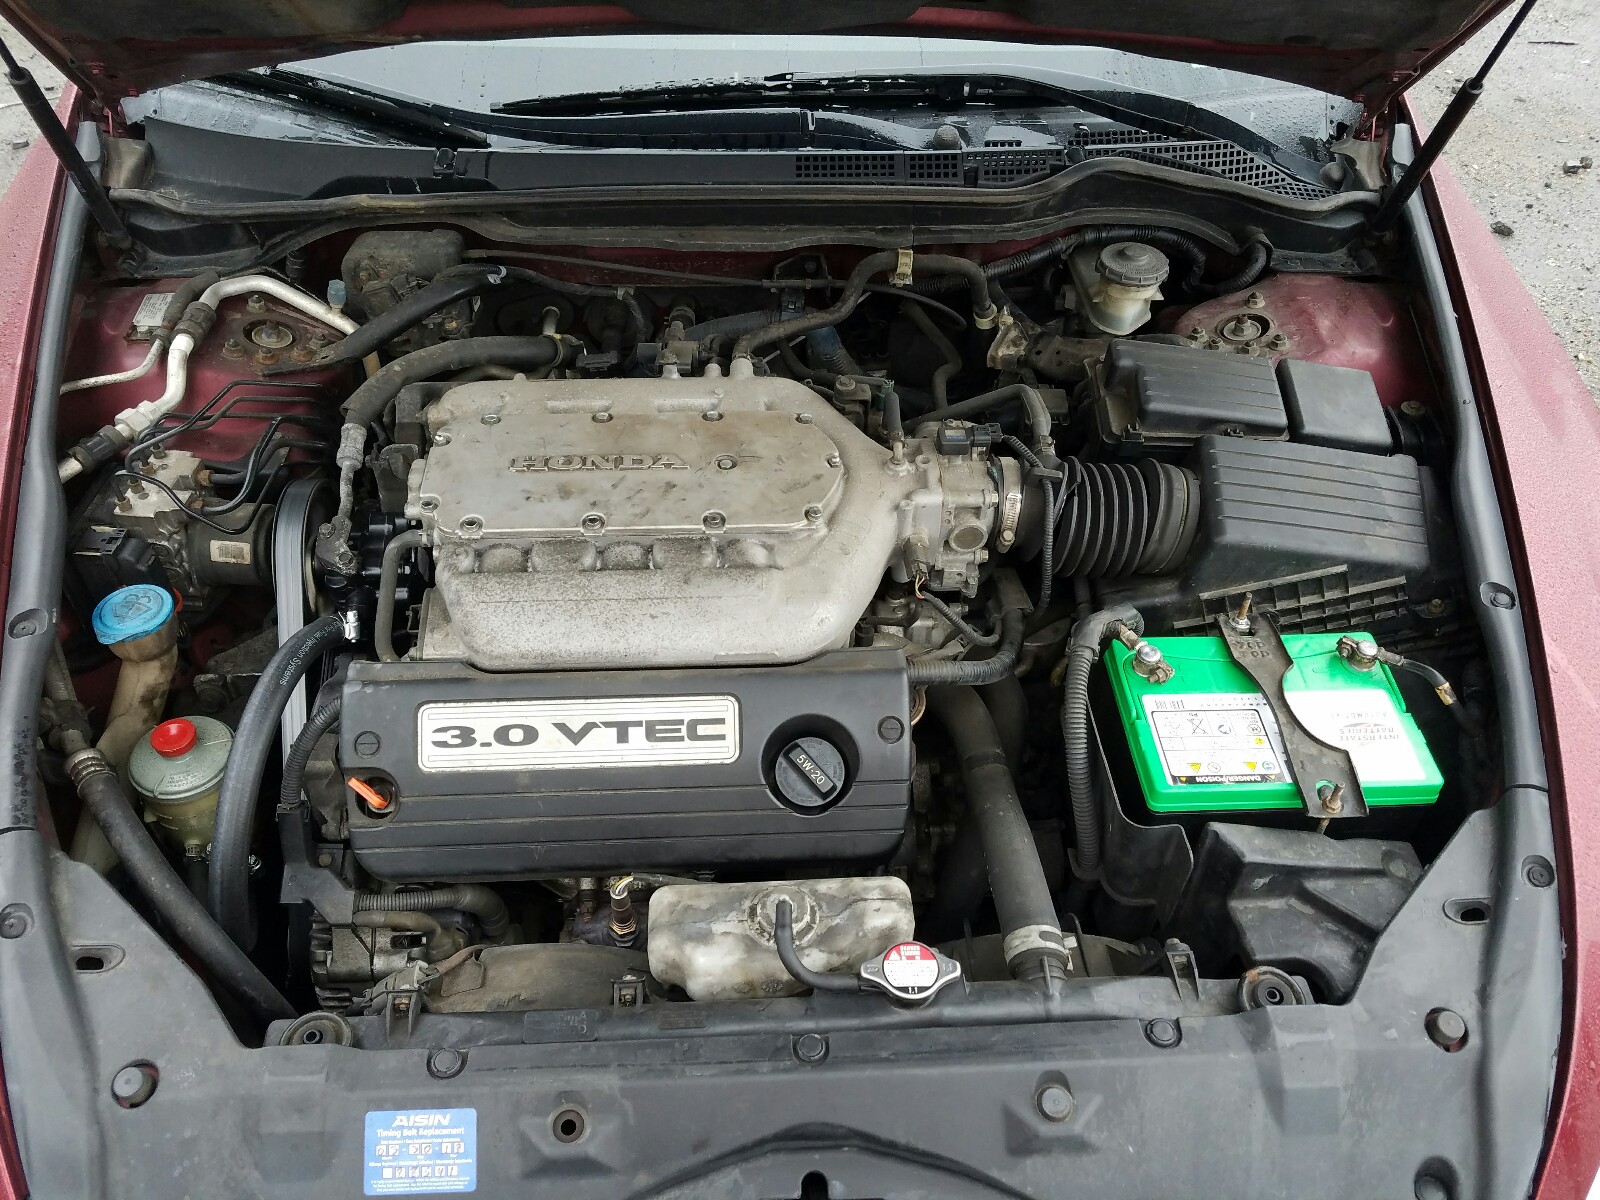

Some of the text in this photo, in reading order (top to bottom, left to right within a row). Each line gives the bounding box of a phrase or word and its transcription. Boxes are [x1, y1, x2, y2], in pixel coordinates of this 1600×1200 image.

[508, 453, 691, 472] HONDA
[313, 629, 328, 641] Fuel
[297, 636, 317, 658] Injection
[280, 657, 302, 686] Systems
[430, 717, 727, 749] 3.0 VTEC
[1339, 734, 1400, 742] INTERSTATE
[1340, 727, 1395, 735] BATTERIES
[796, 754, 825, 785] 5W-20
[908, 986, 918, 994] 1.1
[391, 1113, 451, 1127] AISIN
[376, 1127, 465, 1138] Timing Belt Replacement
